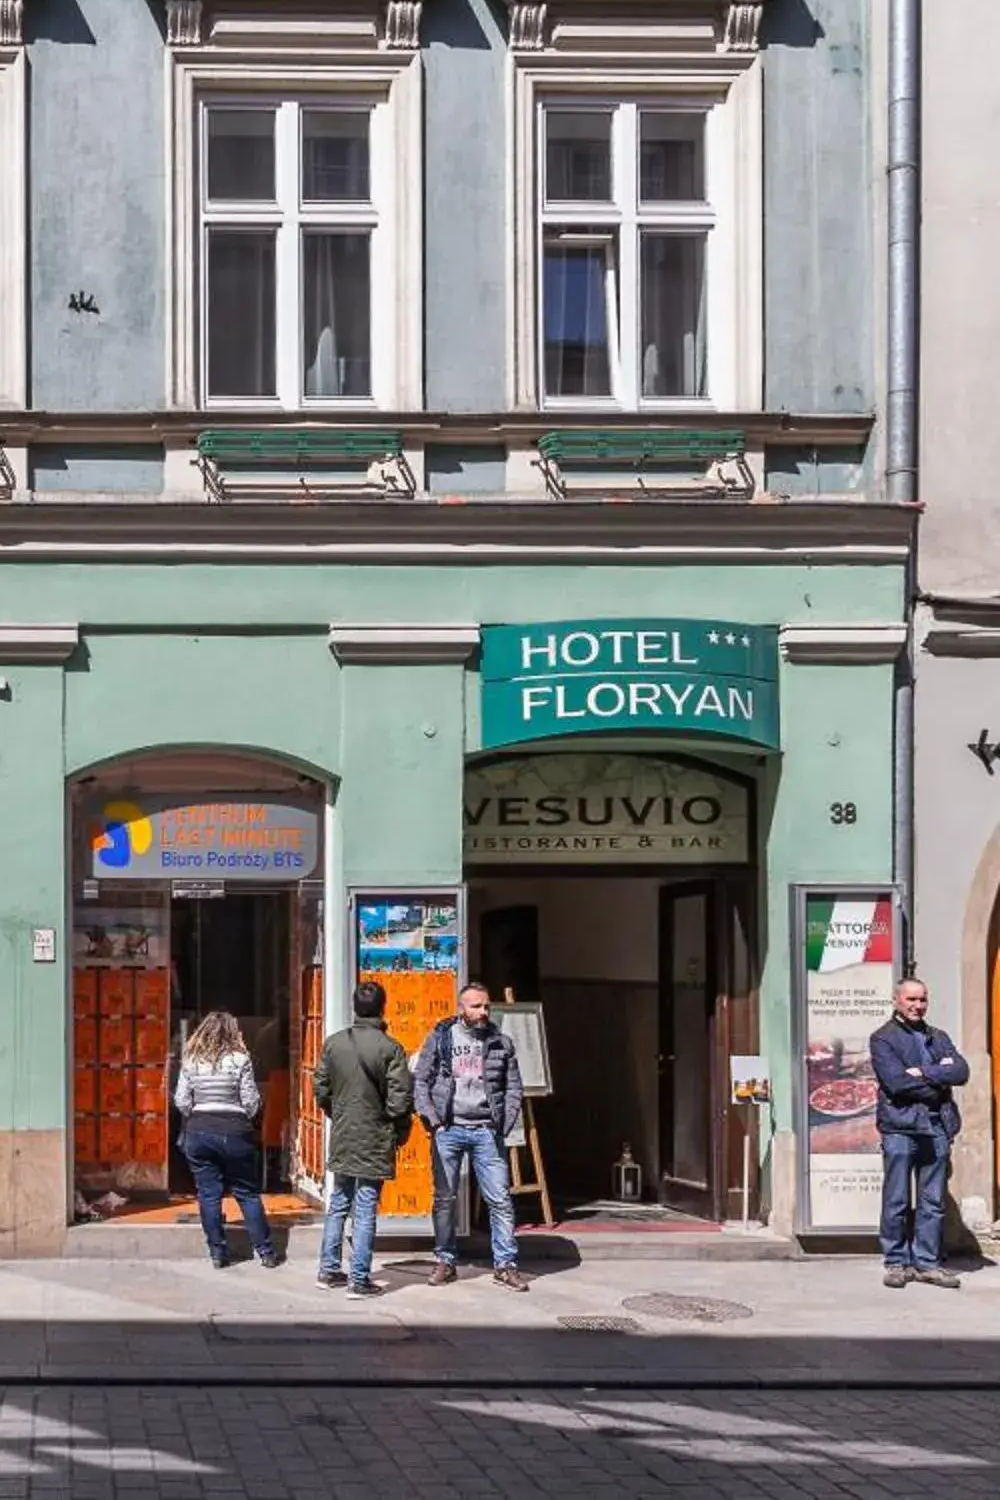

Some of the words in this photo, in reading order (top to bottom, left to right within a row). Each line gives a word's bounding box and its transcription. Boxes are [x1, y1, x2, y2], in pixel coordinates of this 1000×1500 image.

[520, 630, 698, 669] HOTEL
[521, 682, 754, 721] FLORYAN
[463, 795, 723, 827] VESUVIO
[830, 801, 857, 825] 38
[463, 835, 621, 849] ISTORANTE
[637, 836, 654, 848] &
[670, 836, 724, 849] BAR
[161, 851, 202, 867] Biuro
[207, 851, 270, 871] Podróży
[274, 851, 304, 867] BTS
